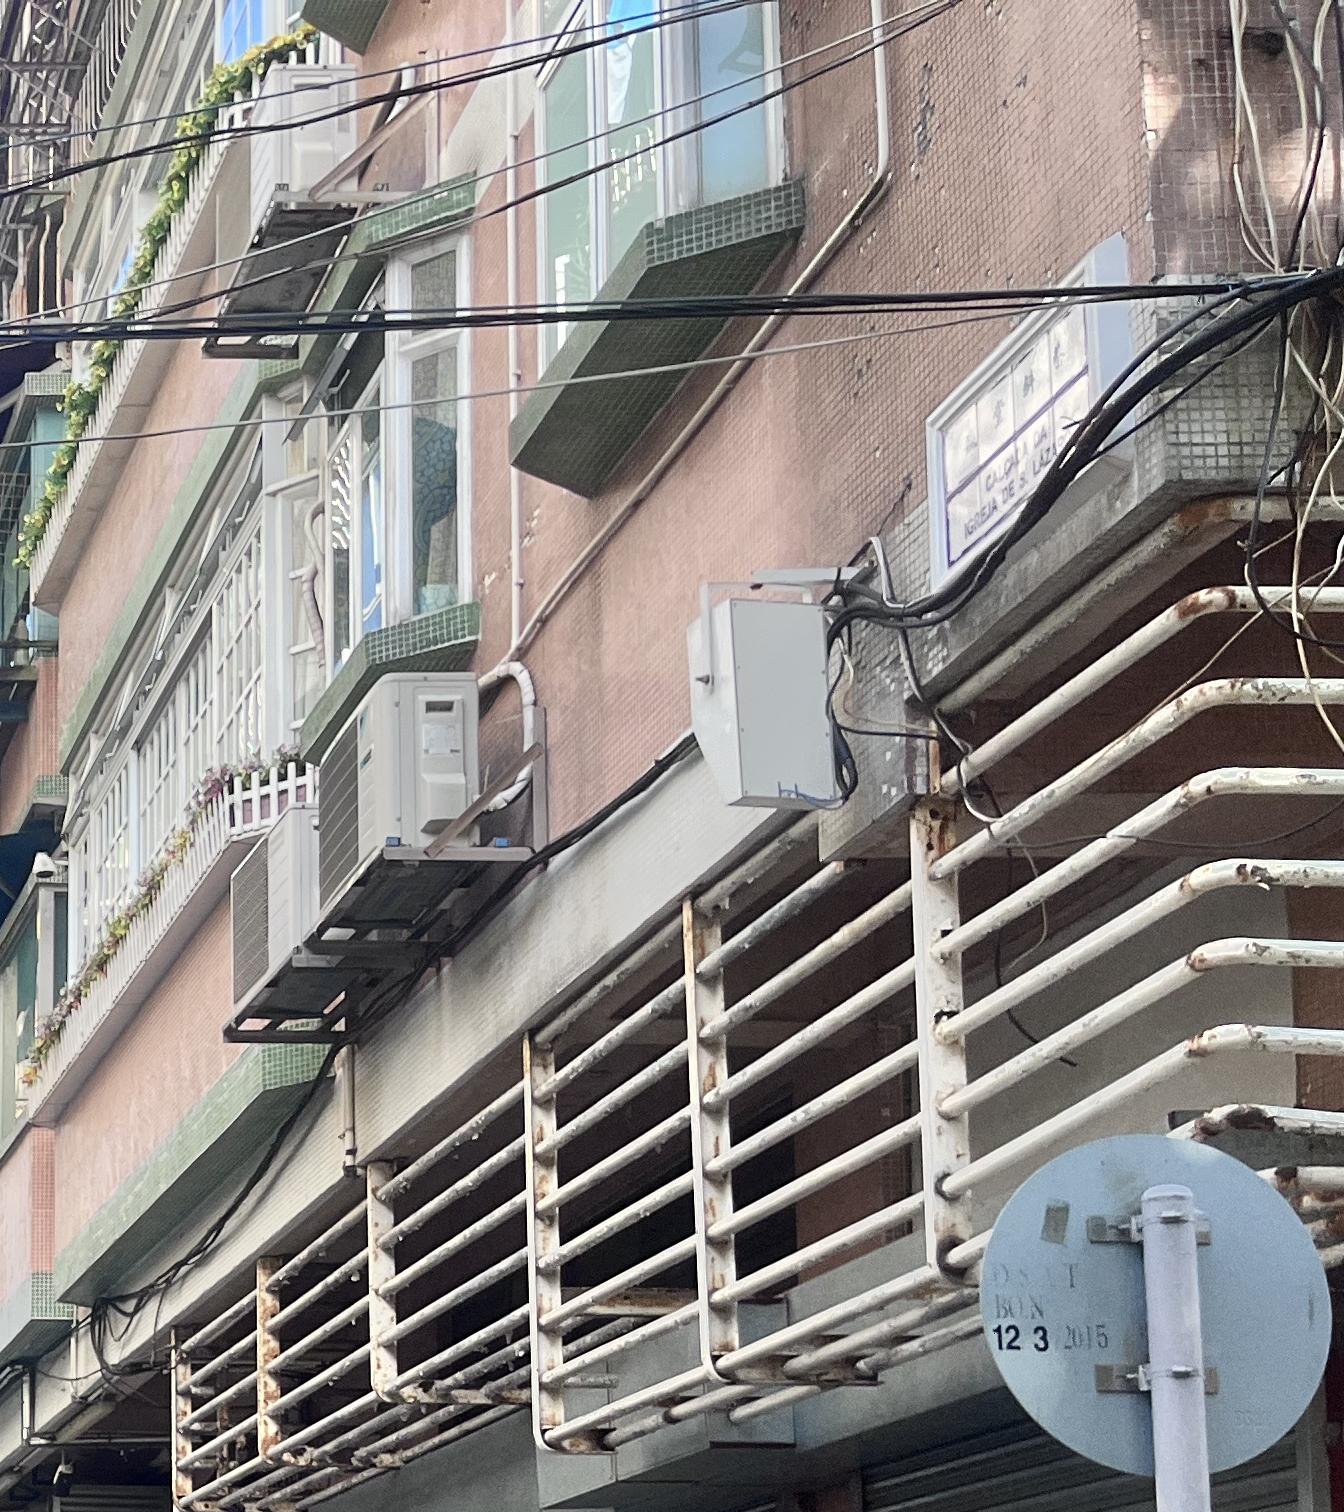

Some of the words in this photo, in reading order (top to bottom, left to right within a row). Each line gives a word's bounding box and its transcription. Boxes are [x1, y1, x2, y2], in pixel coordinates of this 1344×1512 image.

[1002, 481, 1015, 504] DE
[993, 1324, 1021, 1351] 12
[1033, 1326, 1049, 1352] 3
[1064, 1325, 1108, 1349] 2015
